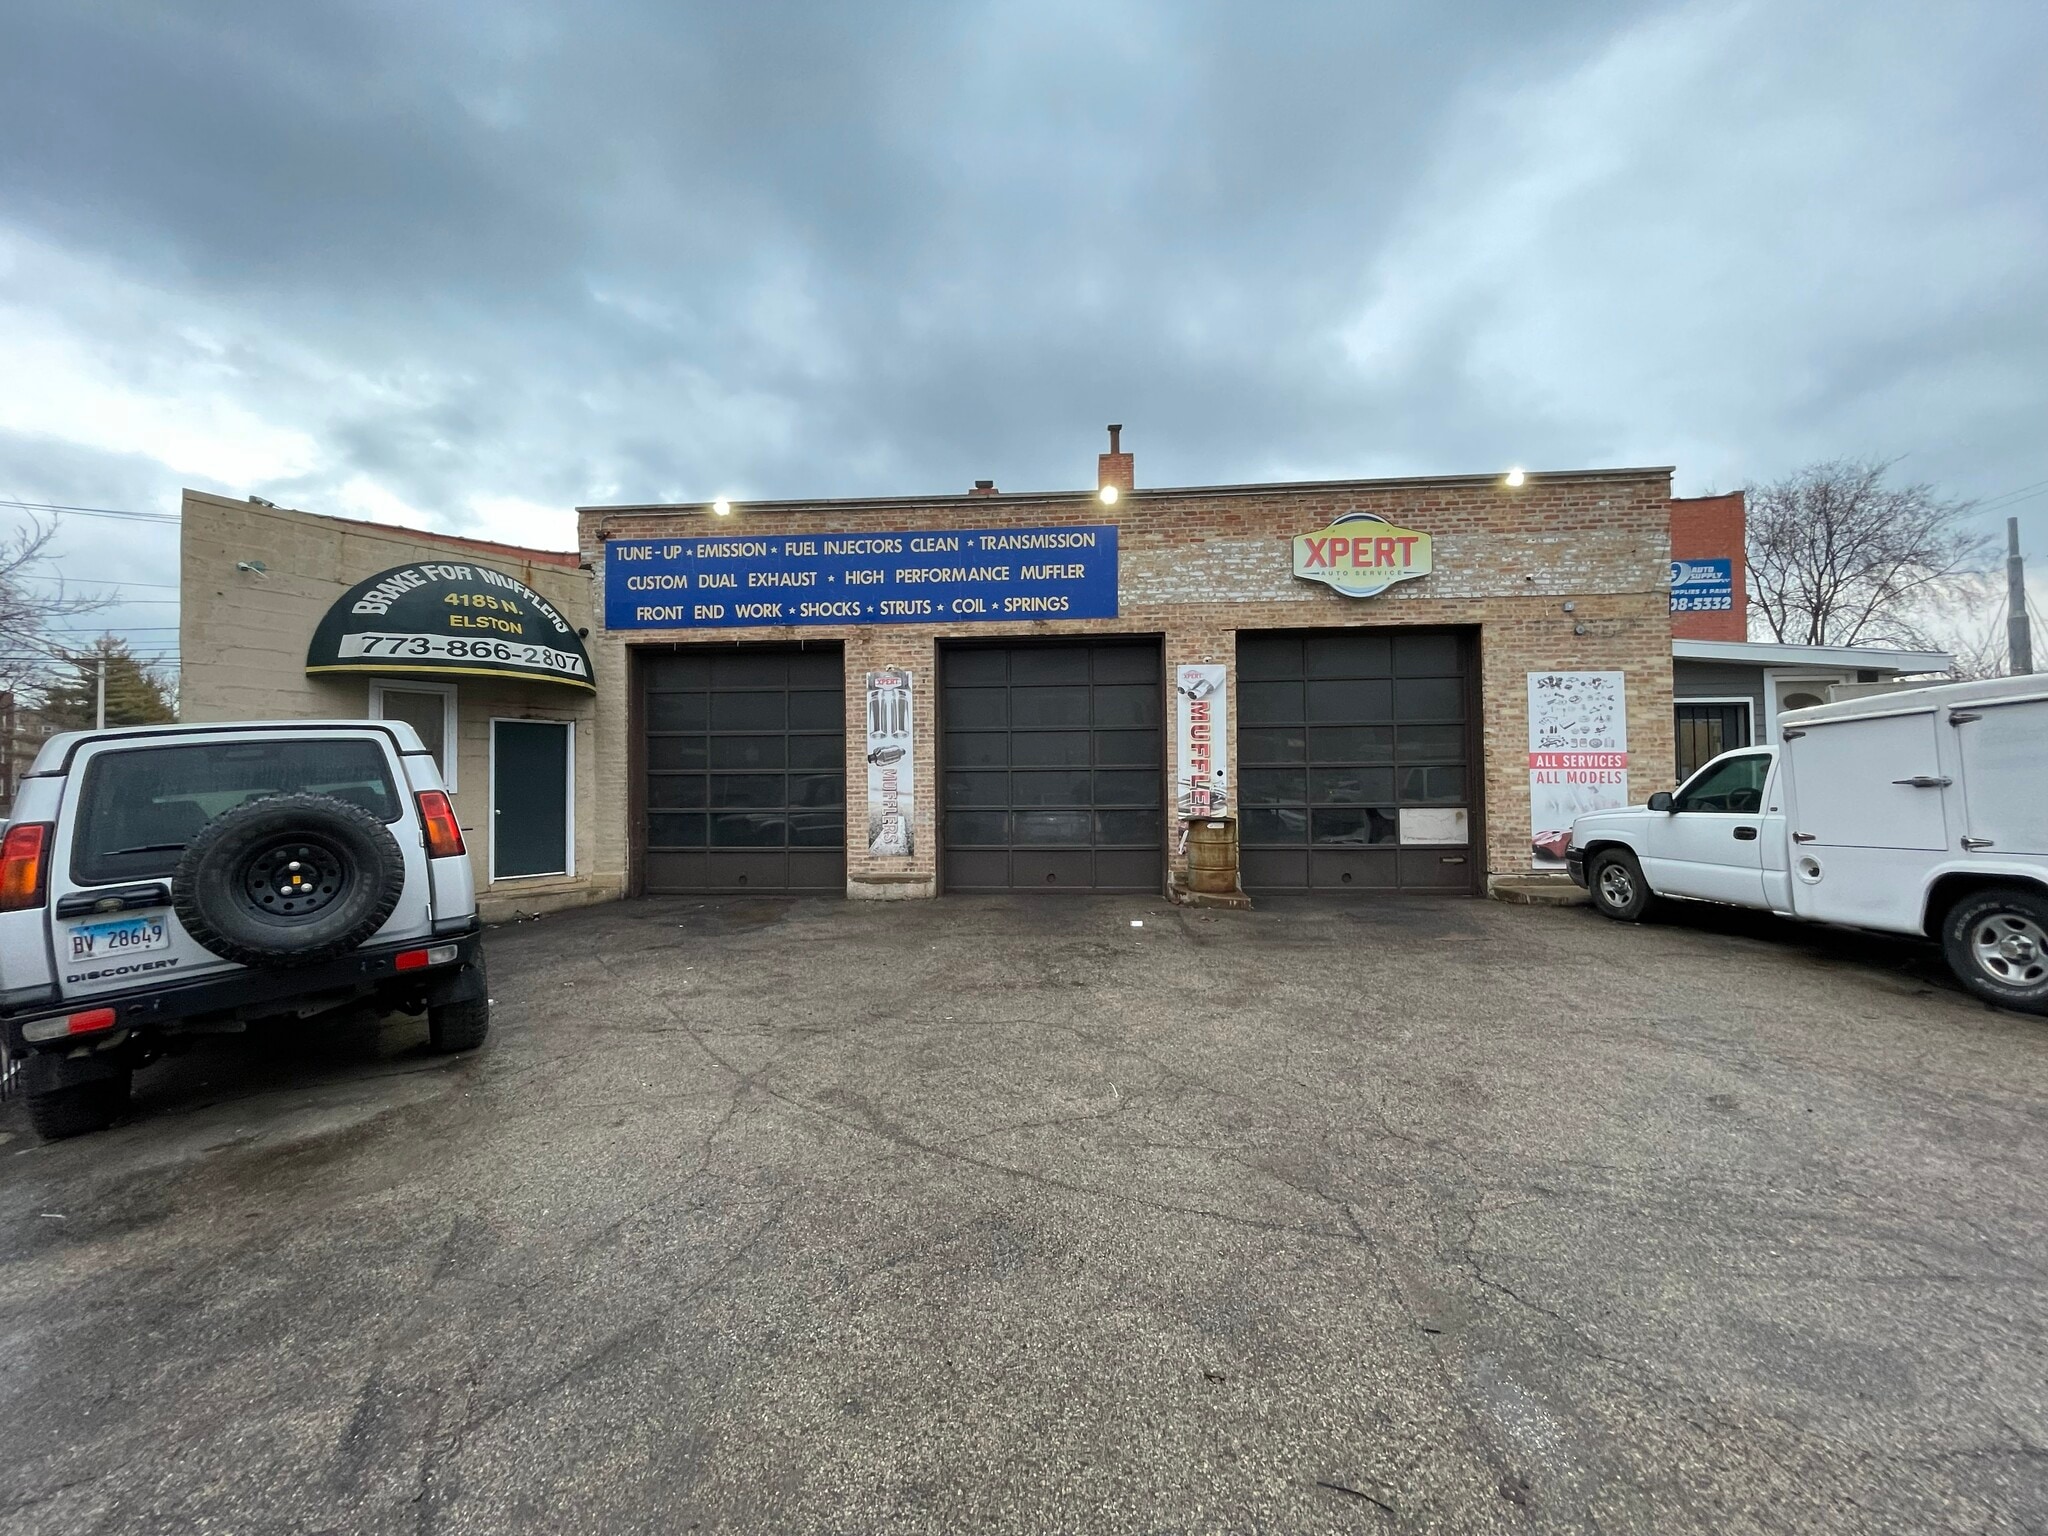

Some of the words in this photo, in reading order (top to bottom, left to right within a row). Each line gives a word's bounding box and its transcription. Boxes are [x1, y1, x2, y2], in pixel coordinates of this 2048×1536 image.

[697, 542, 767, 558] EMISSION
[785, 541, 818, 556] FUEL
[824, 538, 902, 555] INJECTORS
[910, 537, 959, 552] CLEAN
[980, 532, 1095, 551] TRANSMISSION
[1303, 536, 1419, 568] XPERT
[627, 575, 688, 591] CUSTOM
[698, 573, 737, 588] DUAL
[748, 572, 817, 587] EXHAUST
[845, 570, 884, 585] HIGH
[896, 566, 1010, 583] PERFORMANCE
[1020, 564, 1085, 580] MUFFLER
[352, 568, 428, 616] BRAKE
[419, 564, 472, 583] FOR
[476, 566, 569, 634] MUFFLERS
[444, 593, 498, 611] 4185
[502, 600, 524, 615] N.
[636, 606, 683, 621] FRONT
[694, 604, 725, 619] END
[735, 603, 782, 619] WORK
[800, 601, 861, 617] SHOCKS
[880, 599, 932, 615] STRUTS
[952, 598, 987, 614] COIL
[1004, 596, 1070, 613] SPRINGS
[449, 614, 523, 635] ELSTON
[361, 636, 580, 672] 773-866-2807
[1536, 755, 1557, 767] ALL
[1562, 755, 1622, 767] SERVICES
[1536, 771, 1560, 784] ALL
[1567, 771, 1622, 784] MODELS
[882, 769, 898, 844] MUFFLERS
[73, 934, 95, 954] BV
[107, 925, 162, 949] 28649
[66, 958, 179, 984] DISCOVERY
